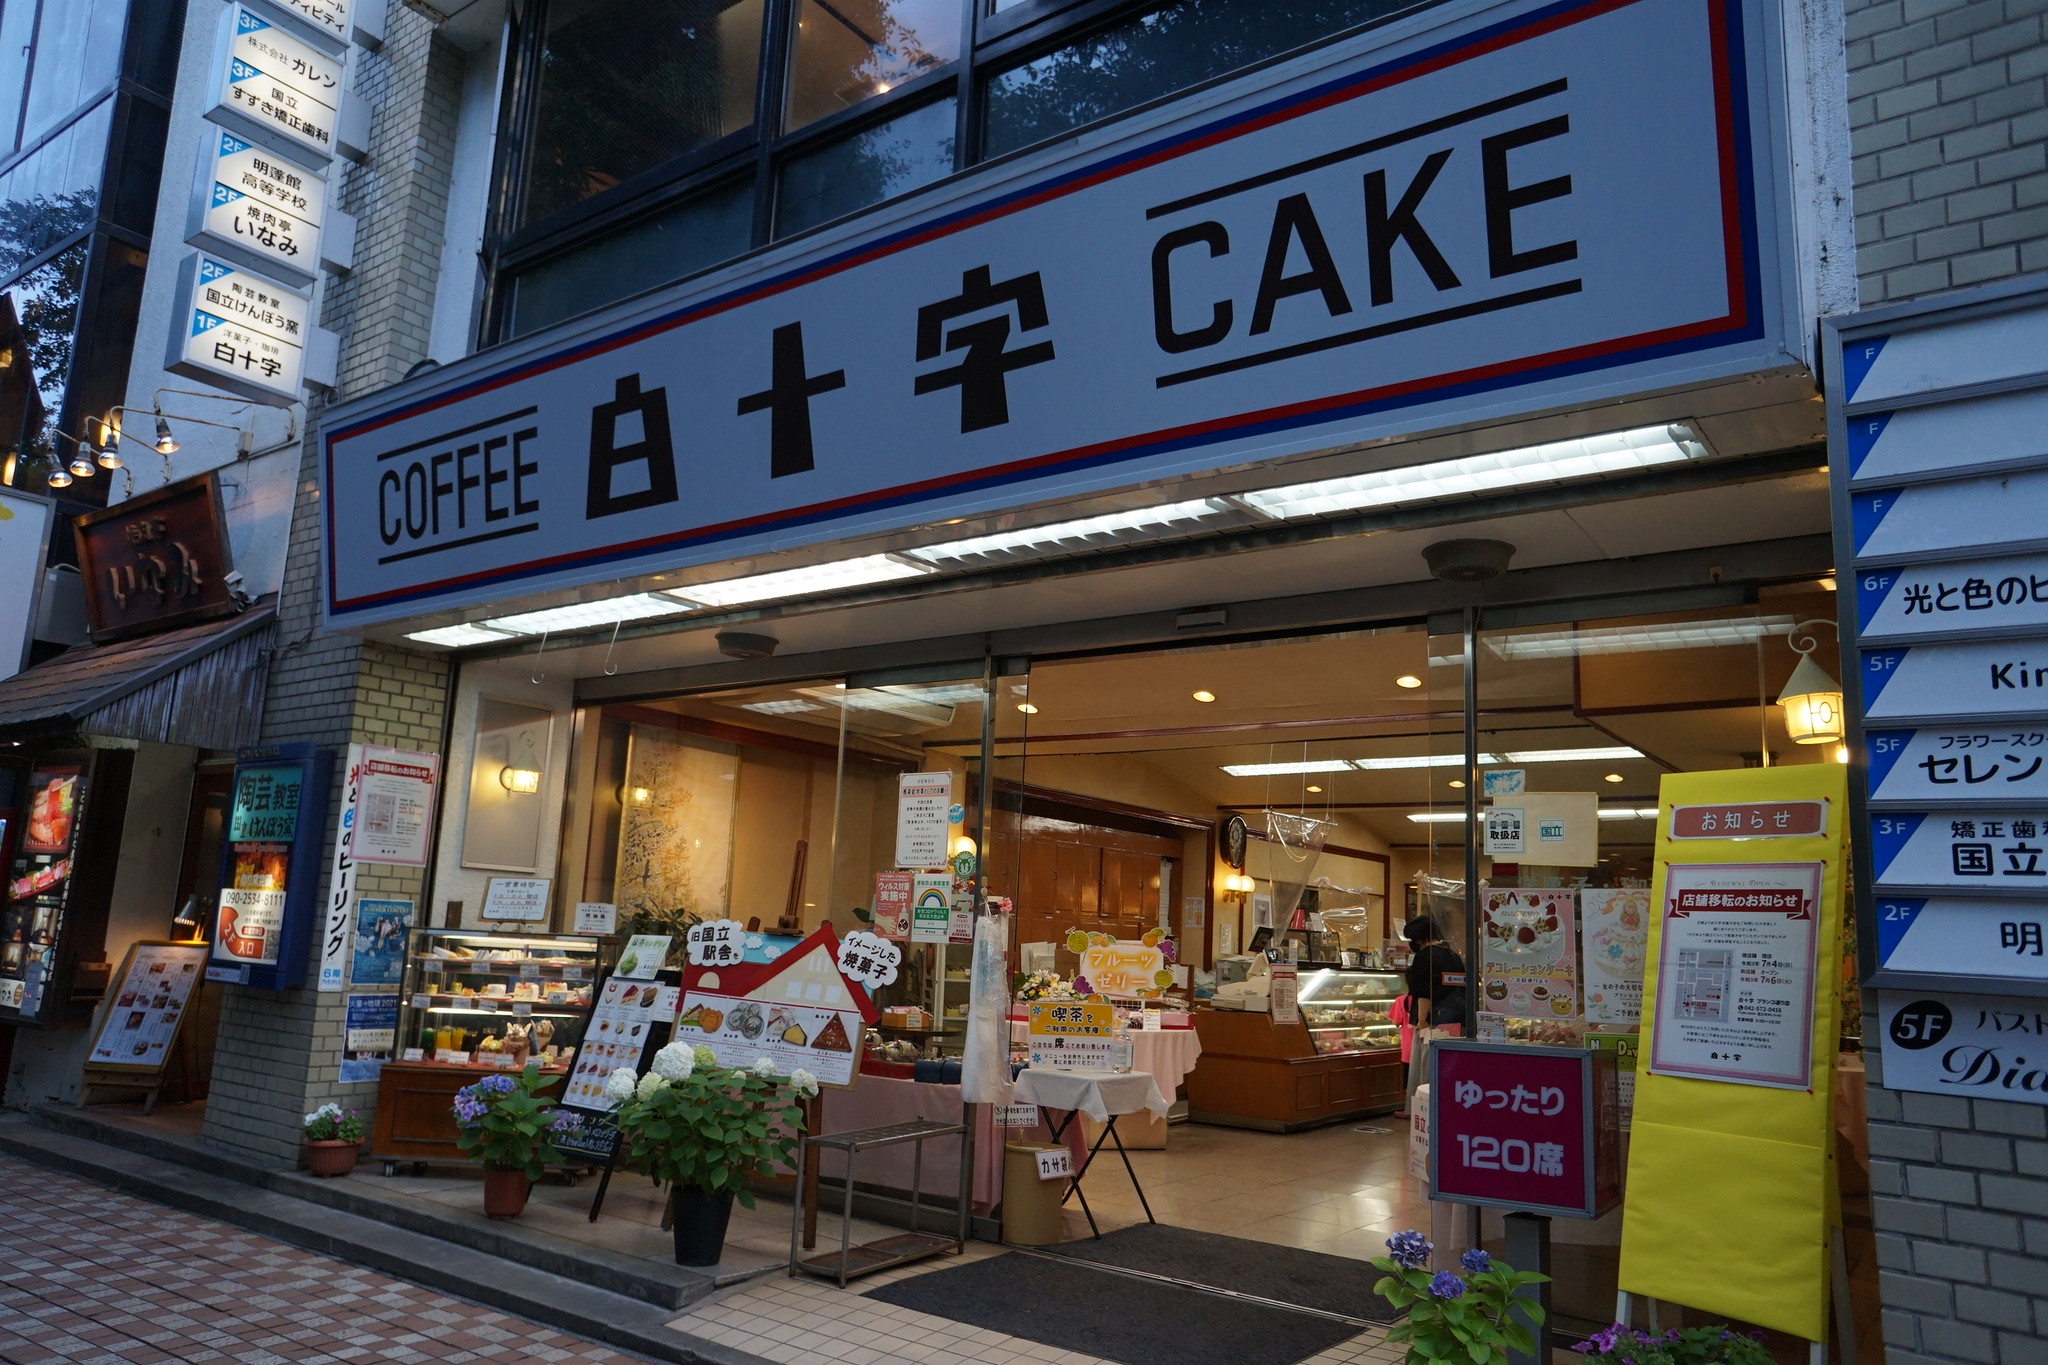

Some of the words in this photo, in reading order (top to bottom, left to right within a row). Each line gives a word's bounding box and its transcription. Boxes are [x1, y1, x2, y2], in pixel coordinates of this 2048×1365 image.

[240, 14, 260, 30] 3F
[232, 63, 254, 77] 3F
[248, 36, 289, 65] 株式会社
[293, 58, 336, 88] ガレン
[271, 87, 298, 110] 国立
[232, 85, 329, 144] すずき矯正歯科
[223, 137, 242, 153] 2F
[215, 186, 238, 202] 2F
[242, 171, 307, 212] 高等学校
[247, 205, 292, 233] 焼肉亭
[234, 215, 298, 256] いなみ
[202, 262, 224, 278] 2F
[232, 282, 280, 310] 陶芸教室
[197, 315, 217, 330] 1F
[379, 426, 539, 549] COFFEE
[585, 264, 1056, 520] 白十字
[1152, 114, 1579, 356] CAKE
[214, 342, 282, 377] 白十字
[1863, 575, 1889, 591] 6F
[1870, 656, 1895, 672] 5F
[1938, 731, 2048, 750] フラワースク
[1876, 738, 1900, 753] 5F
[1918, 754, 2043, 784] セレン
[370, 762, 429, 778] 店舗移転のお知らせ
[236, 773, 300, 812] 陶芸教室
[1701, 810, 1791, 831] お知らせ
[1490, 831, 1520, 840] 取扱店
[1879, 819, 1906, 835] 3F
[1951, 842, 2048, 876] 国立
[226, 892, 283, 906] 090-2534-8111
[881, 891, 907, 901] 実施中
[1682, 893, 1798, 907] 店舗移転のお知らせ
[690, 926, 731, 943] 旧国立
[1884, 904, 1910, 921] 2F
[2000, 921, 2043, 956] 明
[238, 941, 255, 955] 入口
[702, 944, 739, 961] 駅舎を
[849, 937, 896, 963] イメージした
[842, 950, 888, 979] 焼菓子
[1091, 953, 1156, 968] フルーツ
[1486, 962, 1574, 976] デコレーションケーキ
[323, 968, 341, 978] 6階
[1097, 974, 1149, 988] ゼリー
[1051, 1007, 1094, 1023] 喫茶を
[1614, 1009, 1642, 1017] ご予約承
[1044, 1025, 1100, 1034] ご利用のお客様
[1896, 1013, 1944, 1041] 5F
[1454, 1080, 1565, 1116] ゆったり
[1456, 1133, 1564, 1177] 120席
